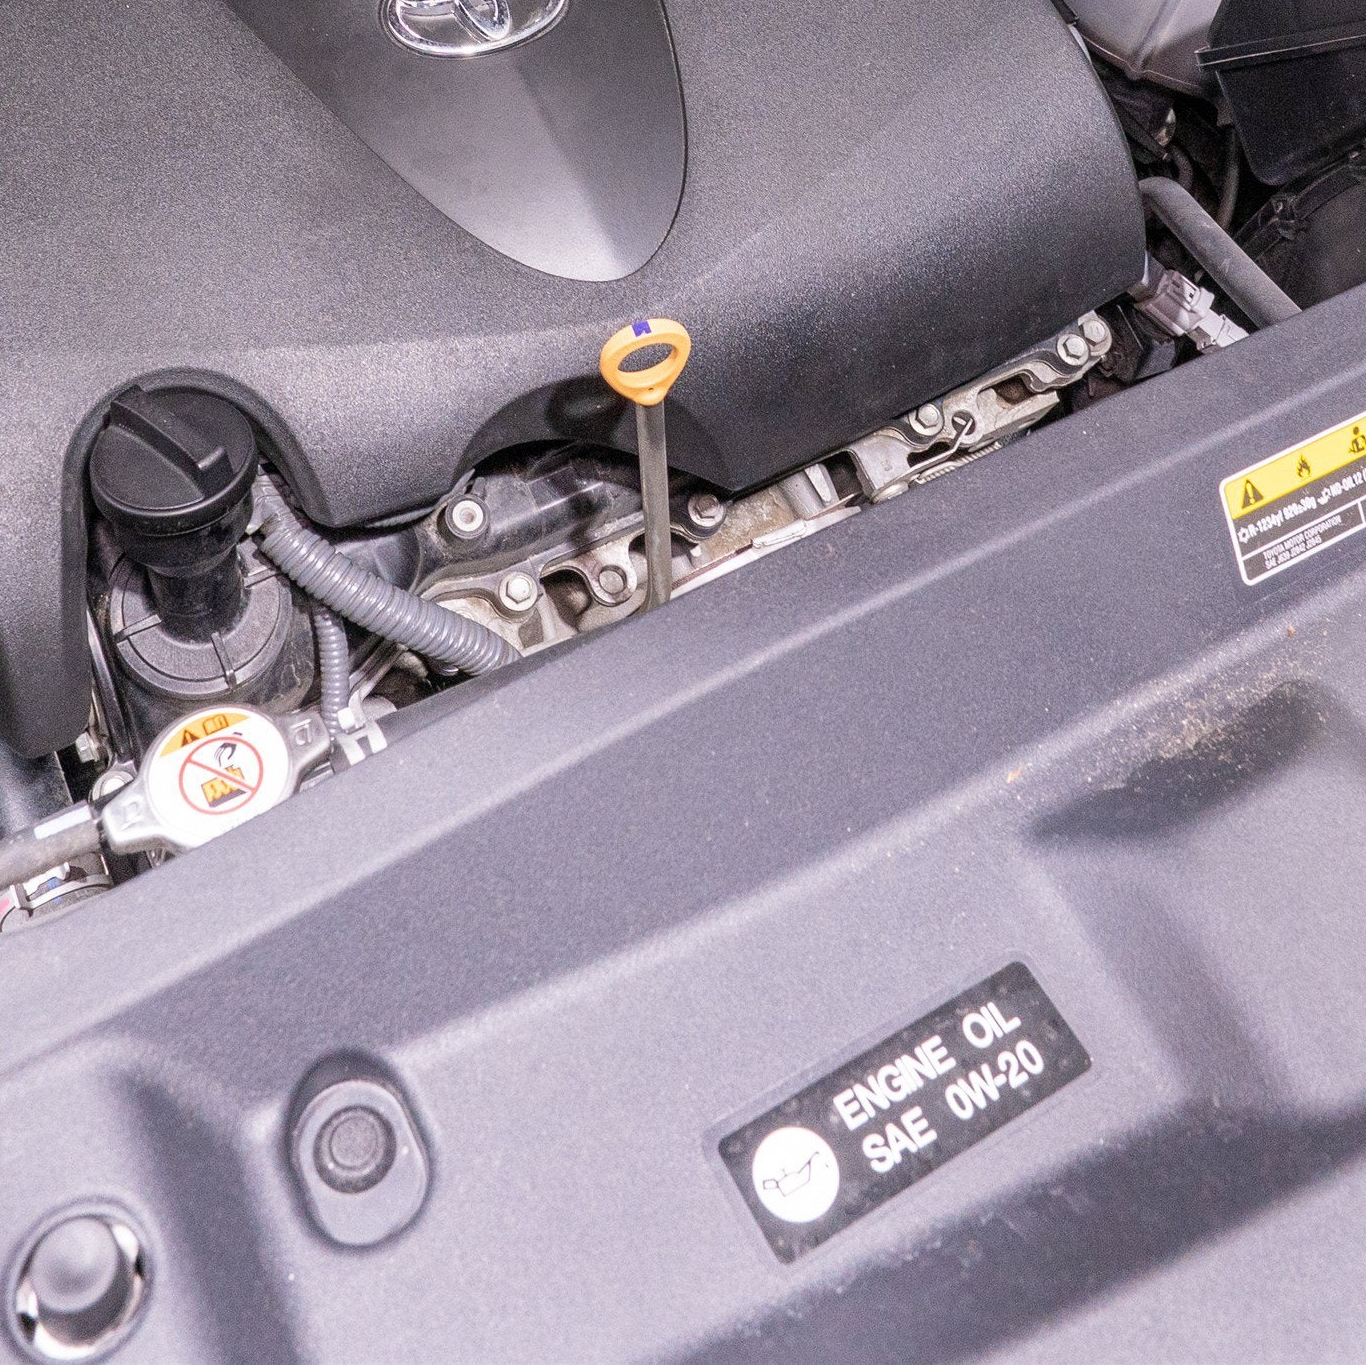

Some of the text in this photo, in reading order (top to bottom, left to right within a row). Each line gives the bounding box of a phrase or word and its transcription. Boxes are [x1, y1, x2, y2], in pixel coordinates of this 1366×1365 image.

[1283, 533, 1305, 549] MOTOR
[832, 1001, 1022, 1132] ENGINE OIL
[860, 1039, 1045, 1174] SAE 0W-20
